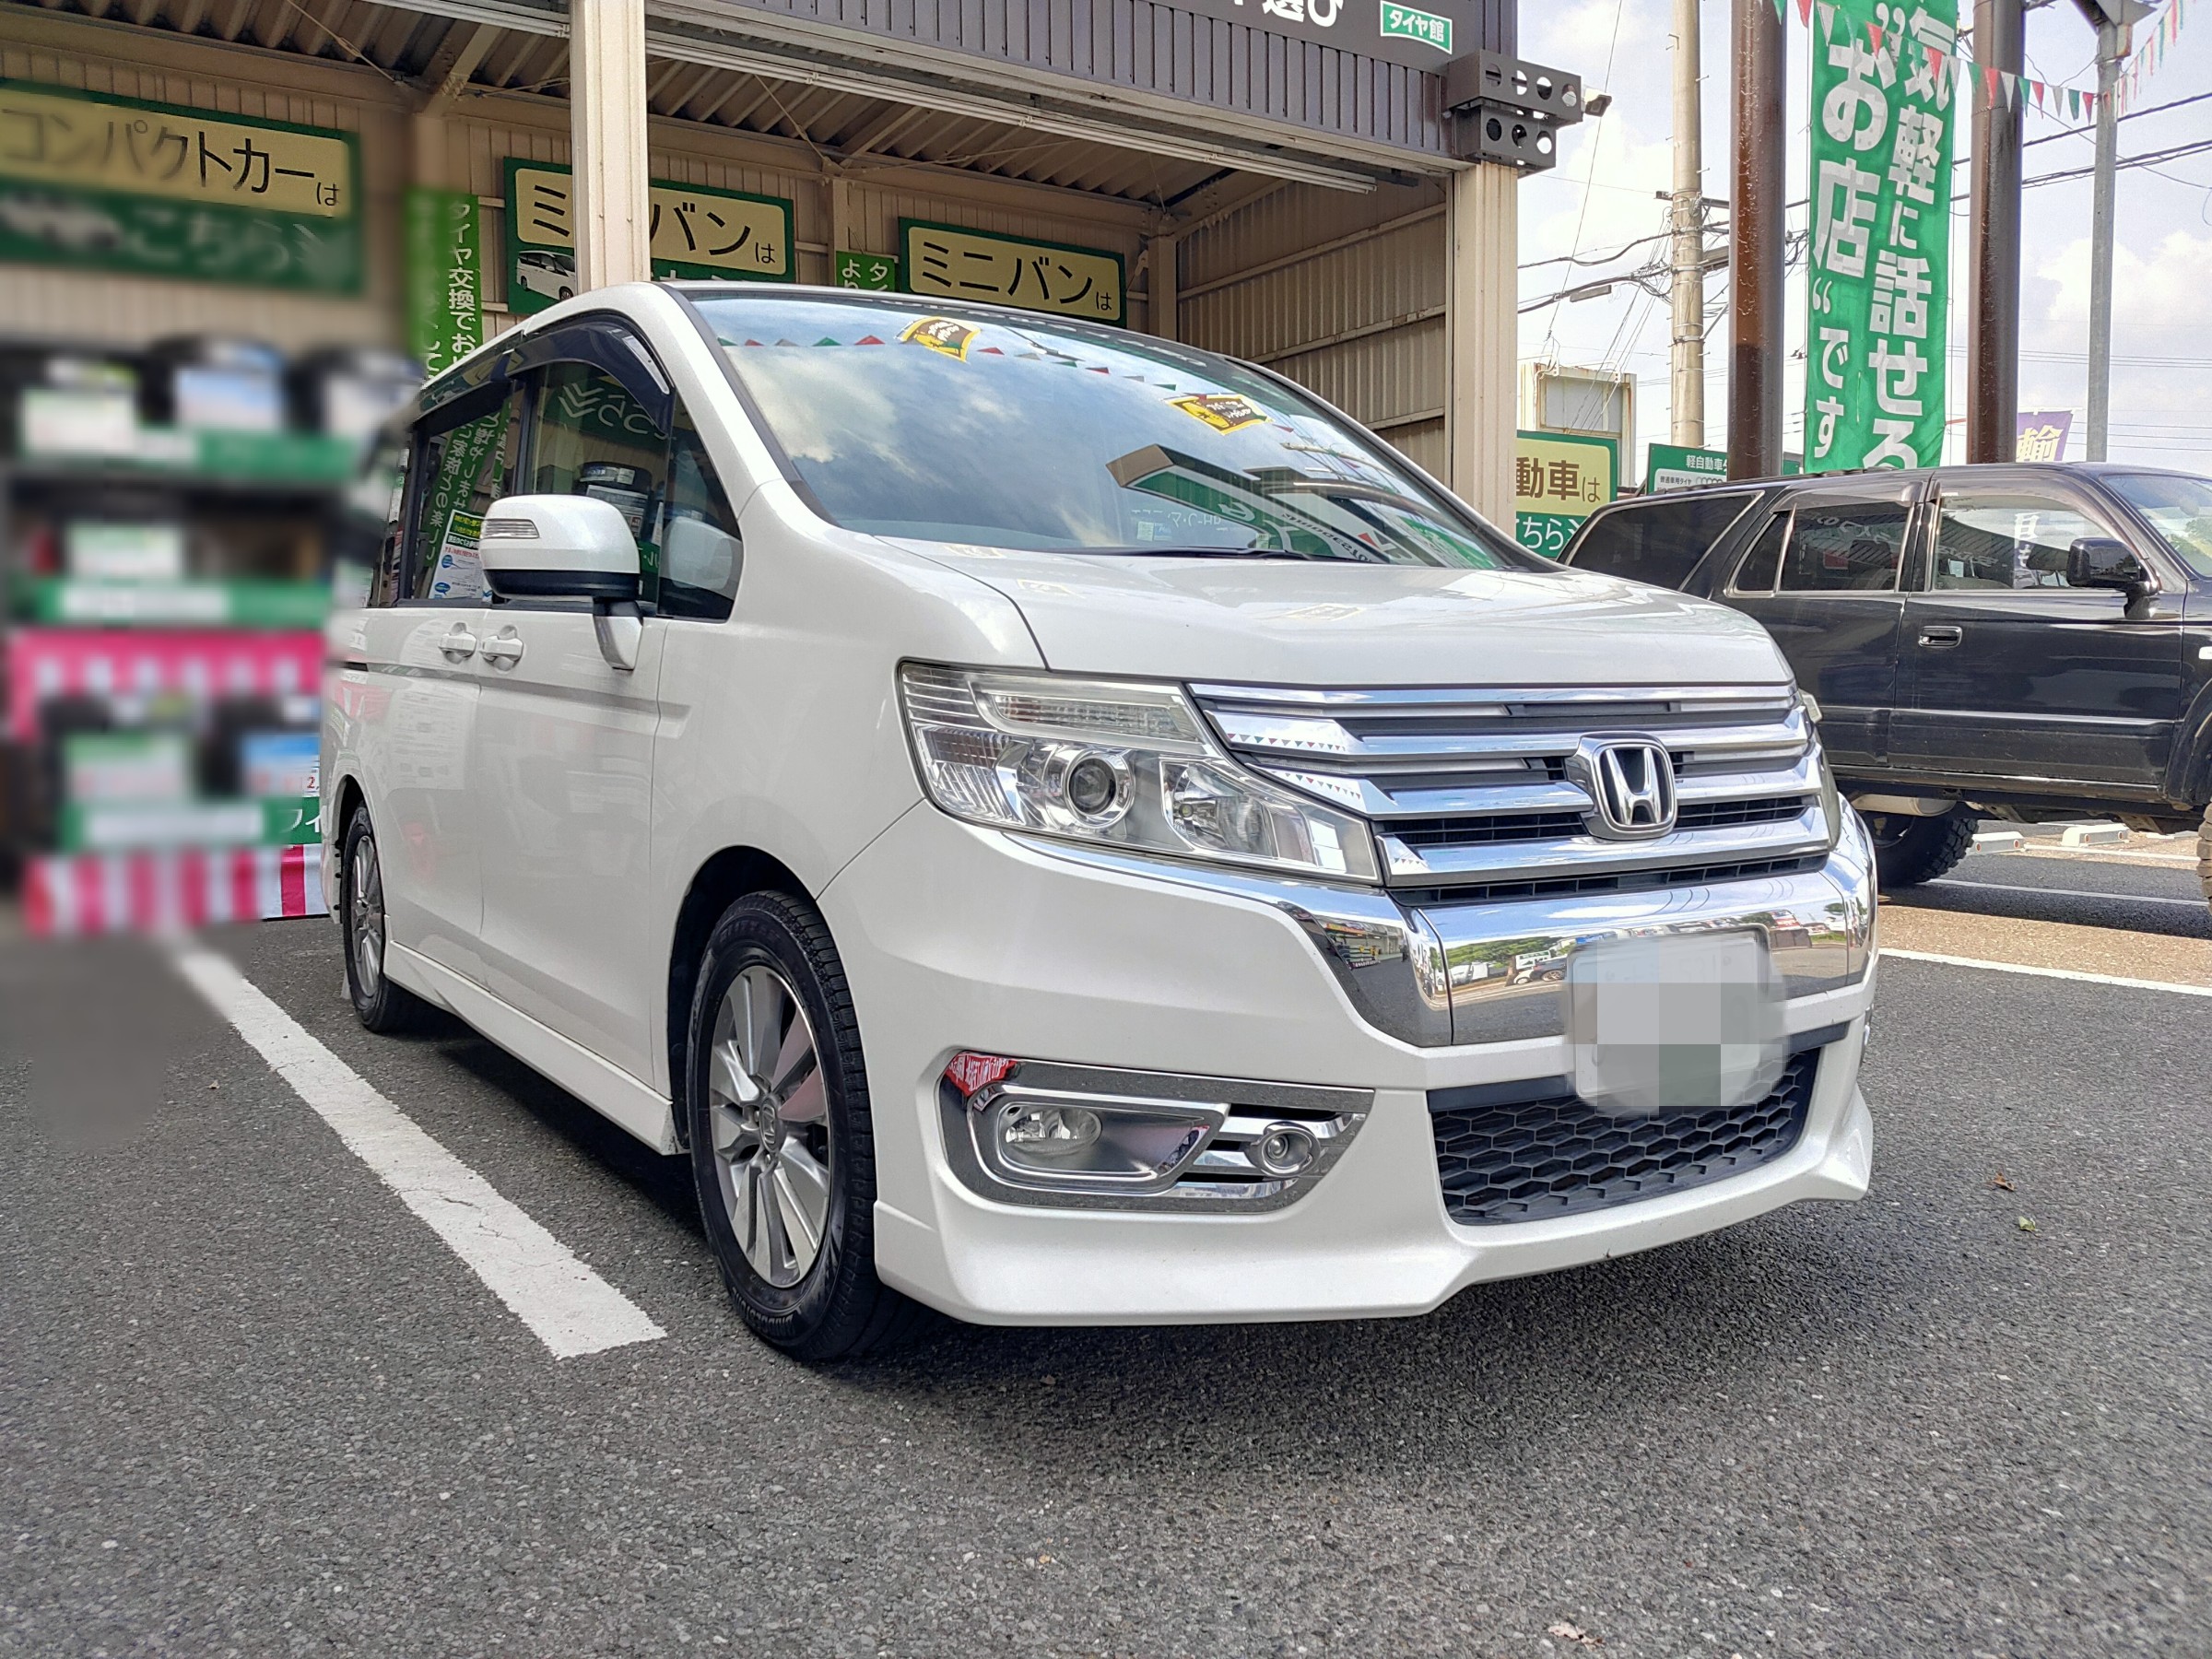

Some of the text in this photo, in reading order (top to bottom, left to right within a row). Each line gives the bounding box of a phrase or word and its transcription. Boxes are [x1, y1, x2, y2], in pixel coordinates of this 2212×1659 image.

[1389, 9, 1445, 42] タイヤ館
[923, 241, 1112, 312] ミニバンは
